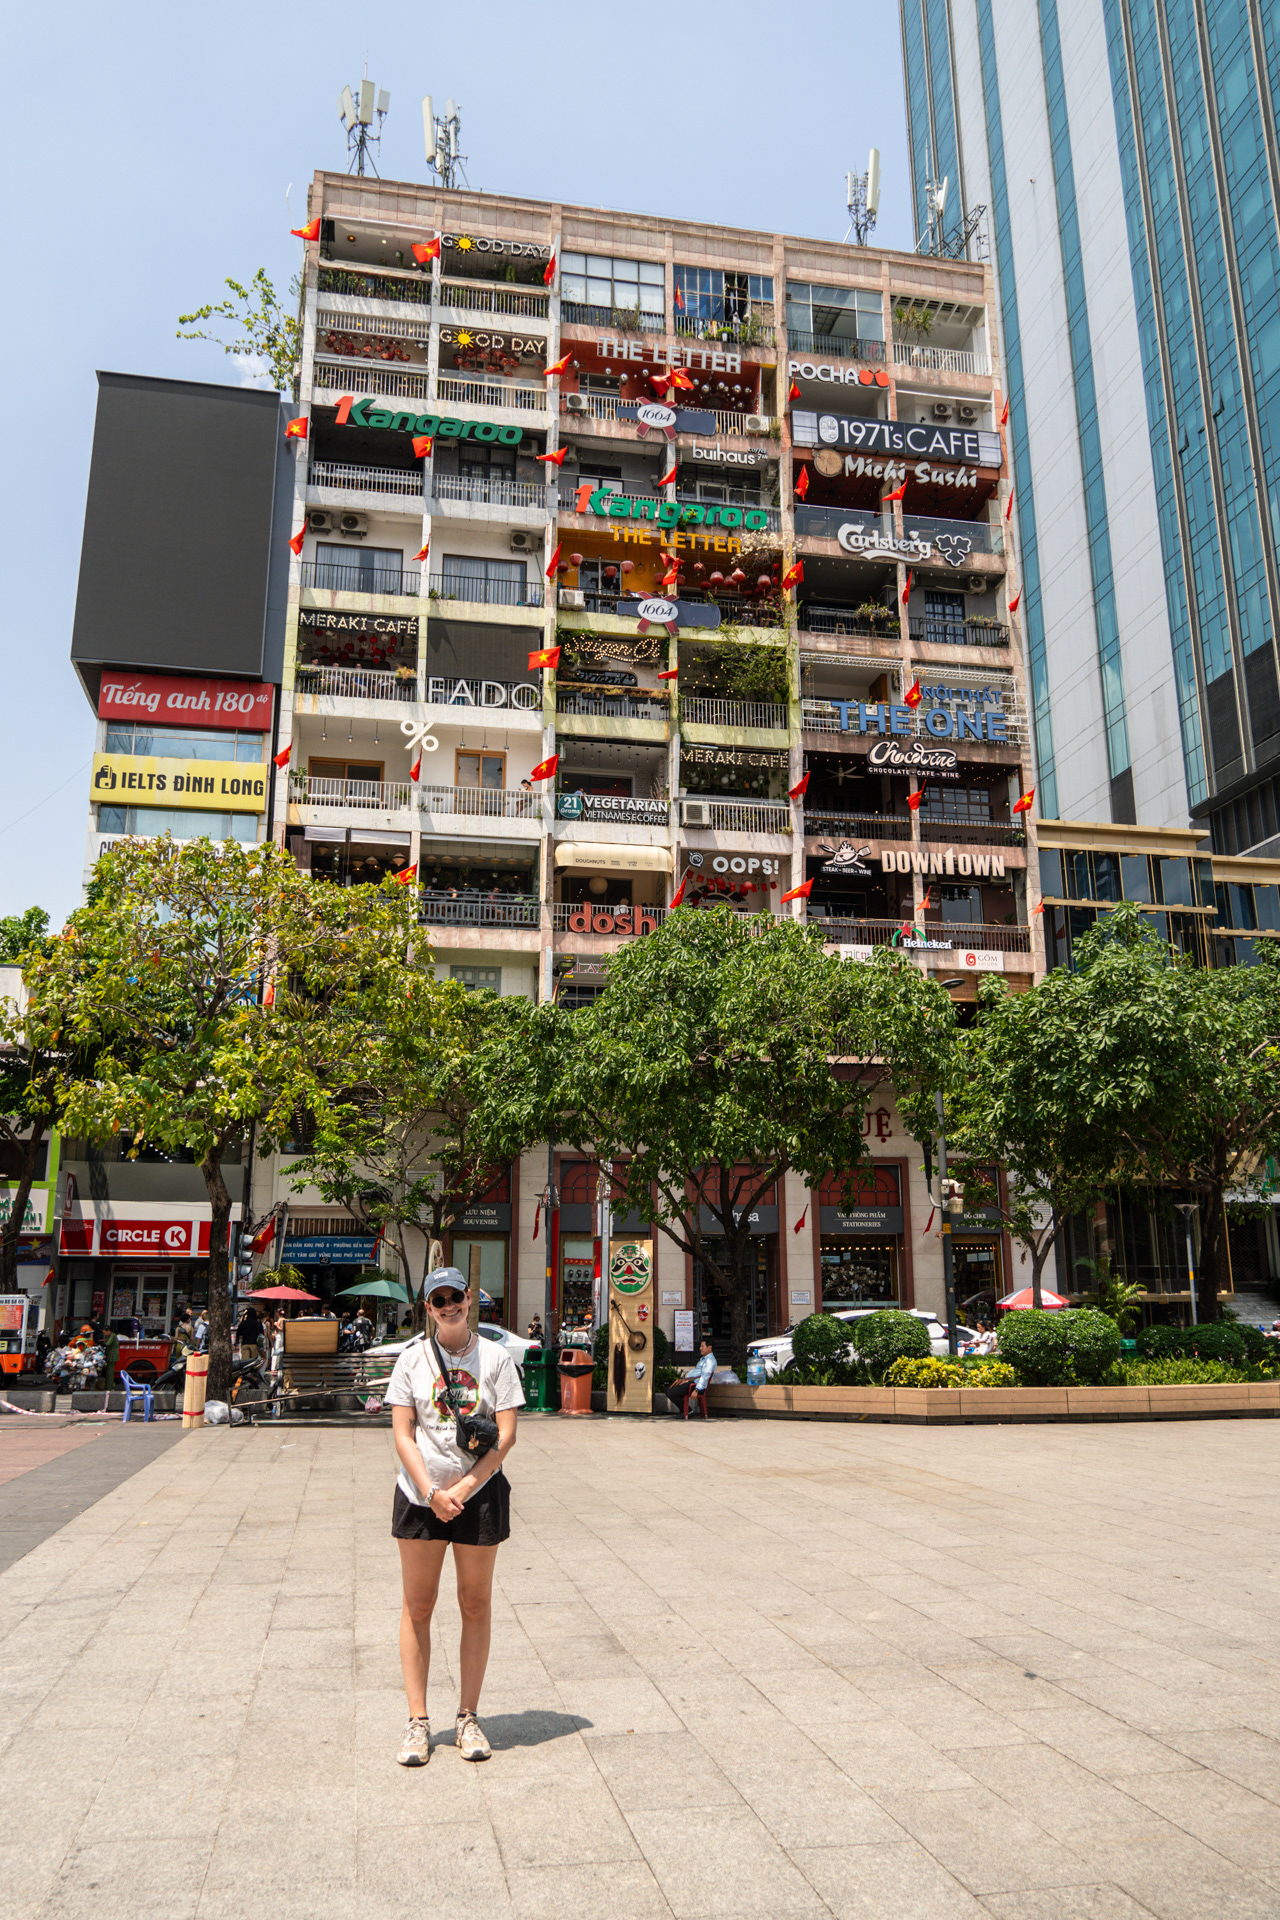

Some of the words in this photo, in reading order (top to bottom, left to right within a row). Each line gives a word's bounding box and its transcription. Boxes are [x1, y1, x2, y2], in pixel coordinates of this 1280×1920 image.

[511, 241, 547, 258] DAY
[511, 337, 545, 354] DAY
[598, 336, 643, 361] THE
[653, 343, 741, 374] LETTER
[788, 361, 859, 385] POCHA
[334, 396, 523, 445] Kangaroo
[642, 409, 673, 422] 1664
[840, 419, 903, 449] 1971's
[907, 428, 979, 458] CAFE
[692, 440, 755, 465] buihaus
[845, 454, 906, 481] Michi
[915, 461, 977, 488] Sushi
[574, 484, 767, 530] Kangaroo
[610, 525, 652, 545] THE
[661, 530, 741, 553] LETTER
[837, 523, 932, 560] Carlsberg
[643, 602, 674, 616] 1664
[300, 612, 368, 631] MERAKI
[374, 616, 418, 634] CAFÉ
[103, 683, 160, 712] Tiếng
[167, 691, 210, 710] anh
[214, 692, 254, 713] 180
[428, 677, 541, 710] FADO
[922, 683, 953, 702] NỘI
[957, 685, 1002, 704] THẤT
[830, 701, 911, 735] THE
[925, 708, 1008, 741] ONE
[680, 749, 743, 766] MERAKI
[749, 752, 788, 769] CAFÉ
[868, 767, 910, 775] CHOCOLATE
[121, 772, 167, 790] IELTS
[173, 773, 214, 793] ĐÌNH
[221, 778, 263, 796] LONG
[563, 797, 577, 808] 21
[584, 797, 667, 812] VEGETARIAN
[585, 810, 636, 821] VIETNAMESE
[637, 813, 667, 823] COFFEE
[713, 856, 779, 874] OOPS!
[569, 901, 657, 935] dosh
[903, 938, 952, 950] Heineken
[106, 1229, 160, 1243] CIRCLE
